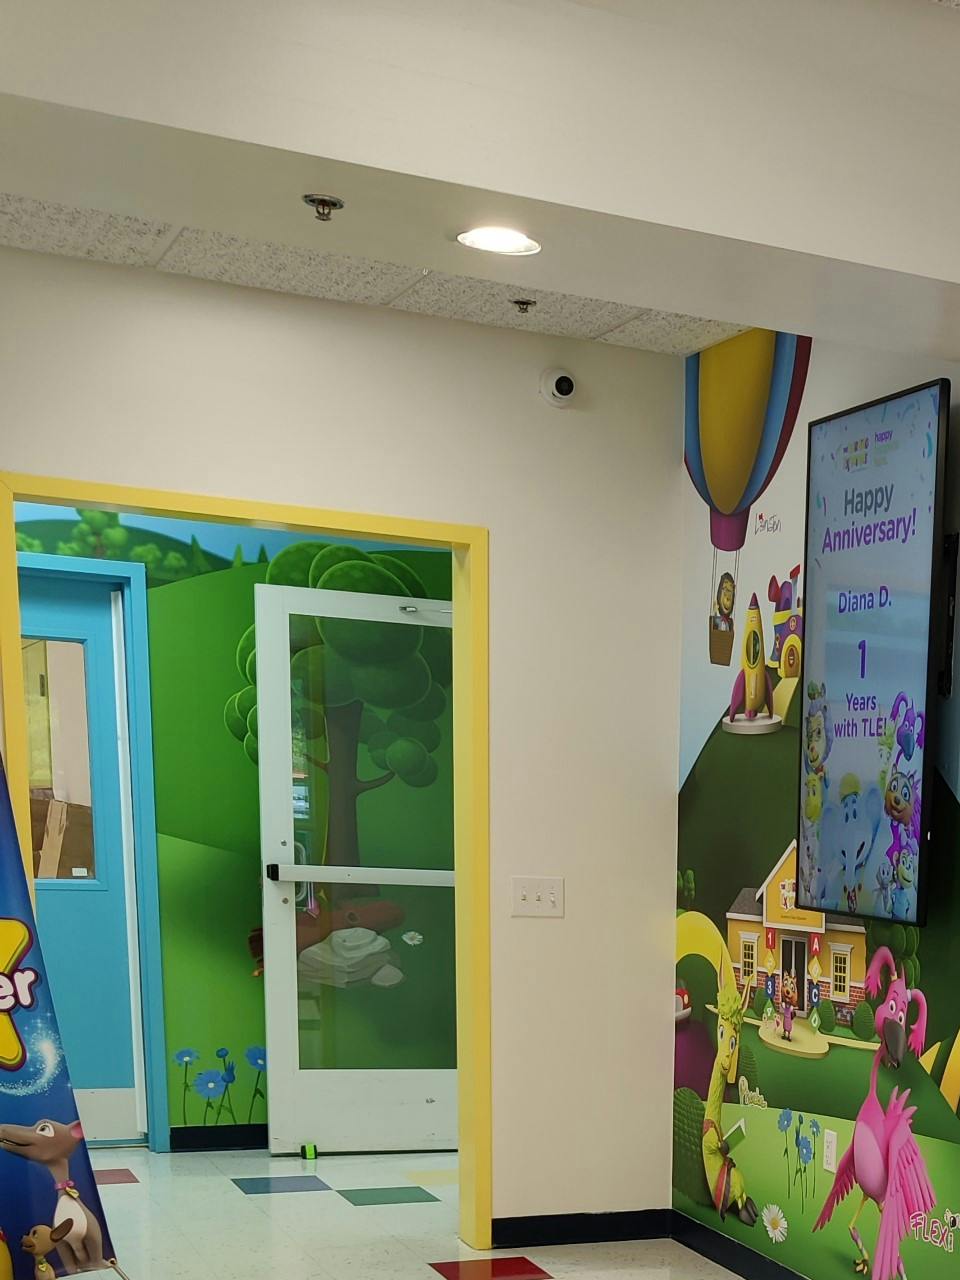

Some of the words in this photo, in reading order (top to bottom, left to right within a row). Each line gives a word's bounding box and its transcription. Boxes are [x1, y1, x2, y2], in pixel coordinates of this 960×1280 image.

[844, 483, 894, 517] Happy
[822, 507, 917, 554] Anniversary!
[838, 590, 874, 614] Diana
[878, 585, 892, 608] D.
[857, 639, 867, 679] 1
[845, 692, 877, 712] Years
[834, 717, 858, 739] with
[861, 717, 888, 738] TLE!
[812, 936, 820, 952] A
[811, 990, 819, 1004] C
